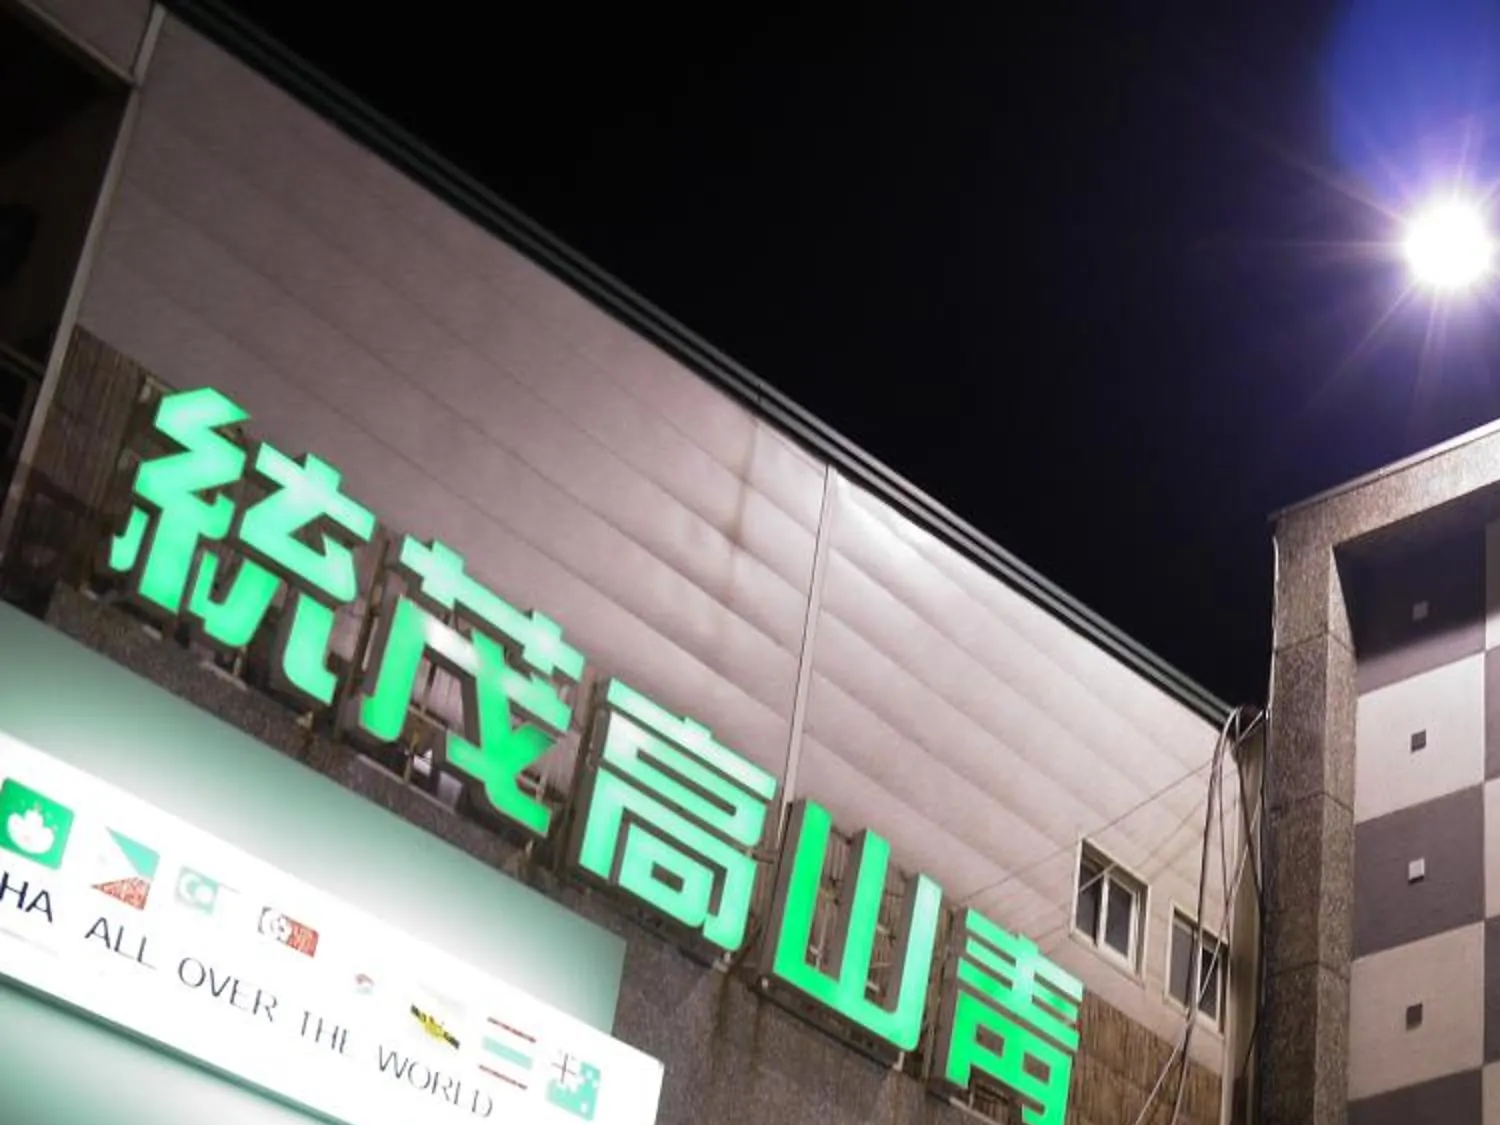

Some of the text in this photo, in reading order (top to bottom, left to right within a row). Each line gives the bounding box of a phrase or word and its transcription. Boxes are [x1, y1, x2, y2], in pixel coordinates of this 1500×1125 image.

[84, 917, 157, 969] ALL
[178, 957, 279, 1022] OVER
[377, 1044, 493, 1119] WORLD
